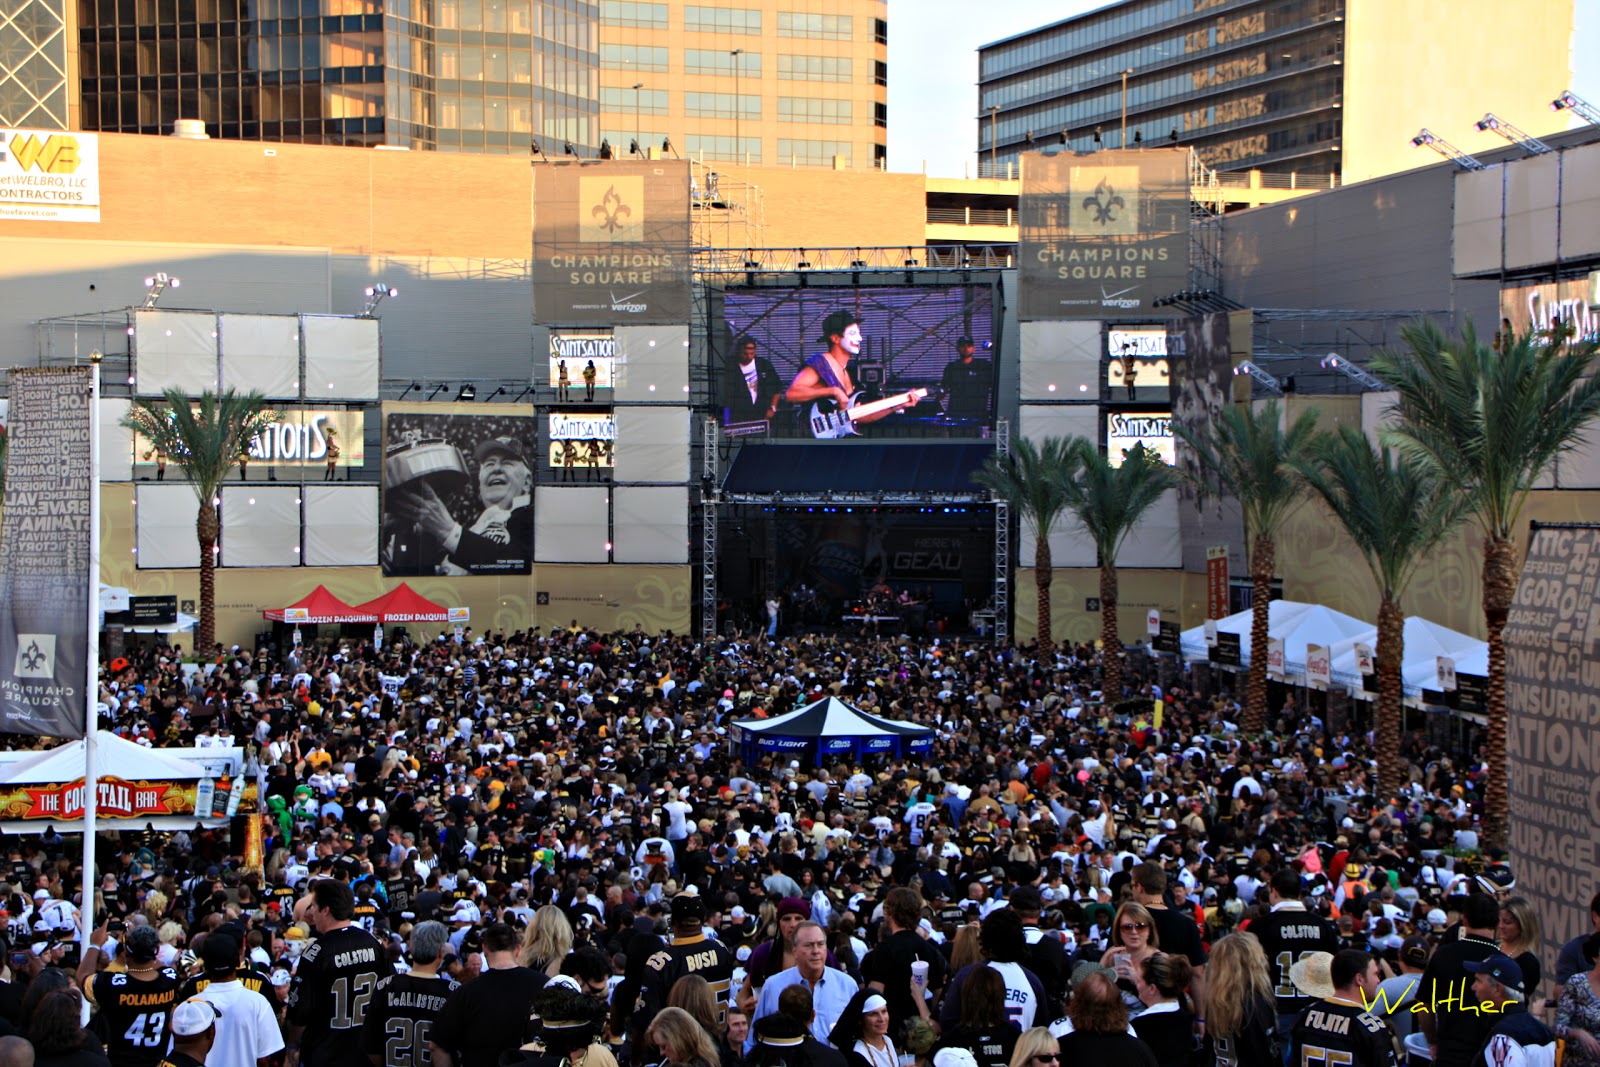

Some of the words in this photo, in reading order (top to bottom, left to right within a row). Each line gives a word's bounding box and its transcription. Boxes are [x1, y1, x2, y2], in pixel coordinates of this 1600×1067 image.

[69, 178, 87, 188] LLC
[551, 254, 673, 268] CHAMPIONS
[1037, 248, 1168, 263] CHAMPIONS
[570, 271, 652, 285] SQUARE
[1058, 265, 1147, 280] SQUARE
[611, 302, 647, 313] verizon
[1102, 298, 1140, 308] verizon
[893, 552, 962, 570] GEAU
[384, 613, 408, 622] FROZEN
[758, 738, 775, 746] BUD
[778, 739, 808, 748] LIGHT
[40, 794, 60, 811] THE
[135, 791, 158, 808] BAR
[1280, 925, 1320, 939] COLSTON
[334, 948, 375, 968] COLSTON
[686, 950, 718, 973] BUSH
[119, 990, 175, 1006] POLAMALU
[331, 972, 378, 1030] 12
[124, 1011, 166, 1047] 43
[1305, 1010, 1350, 1035] FUJITA
